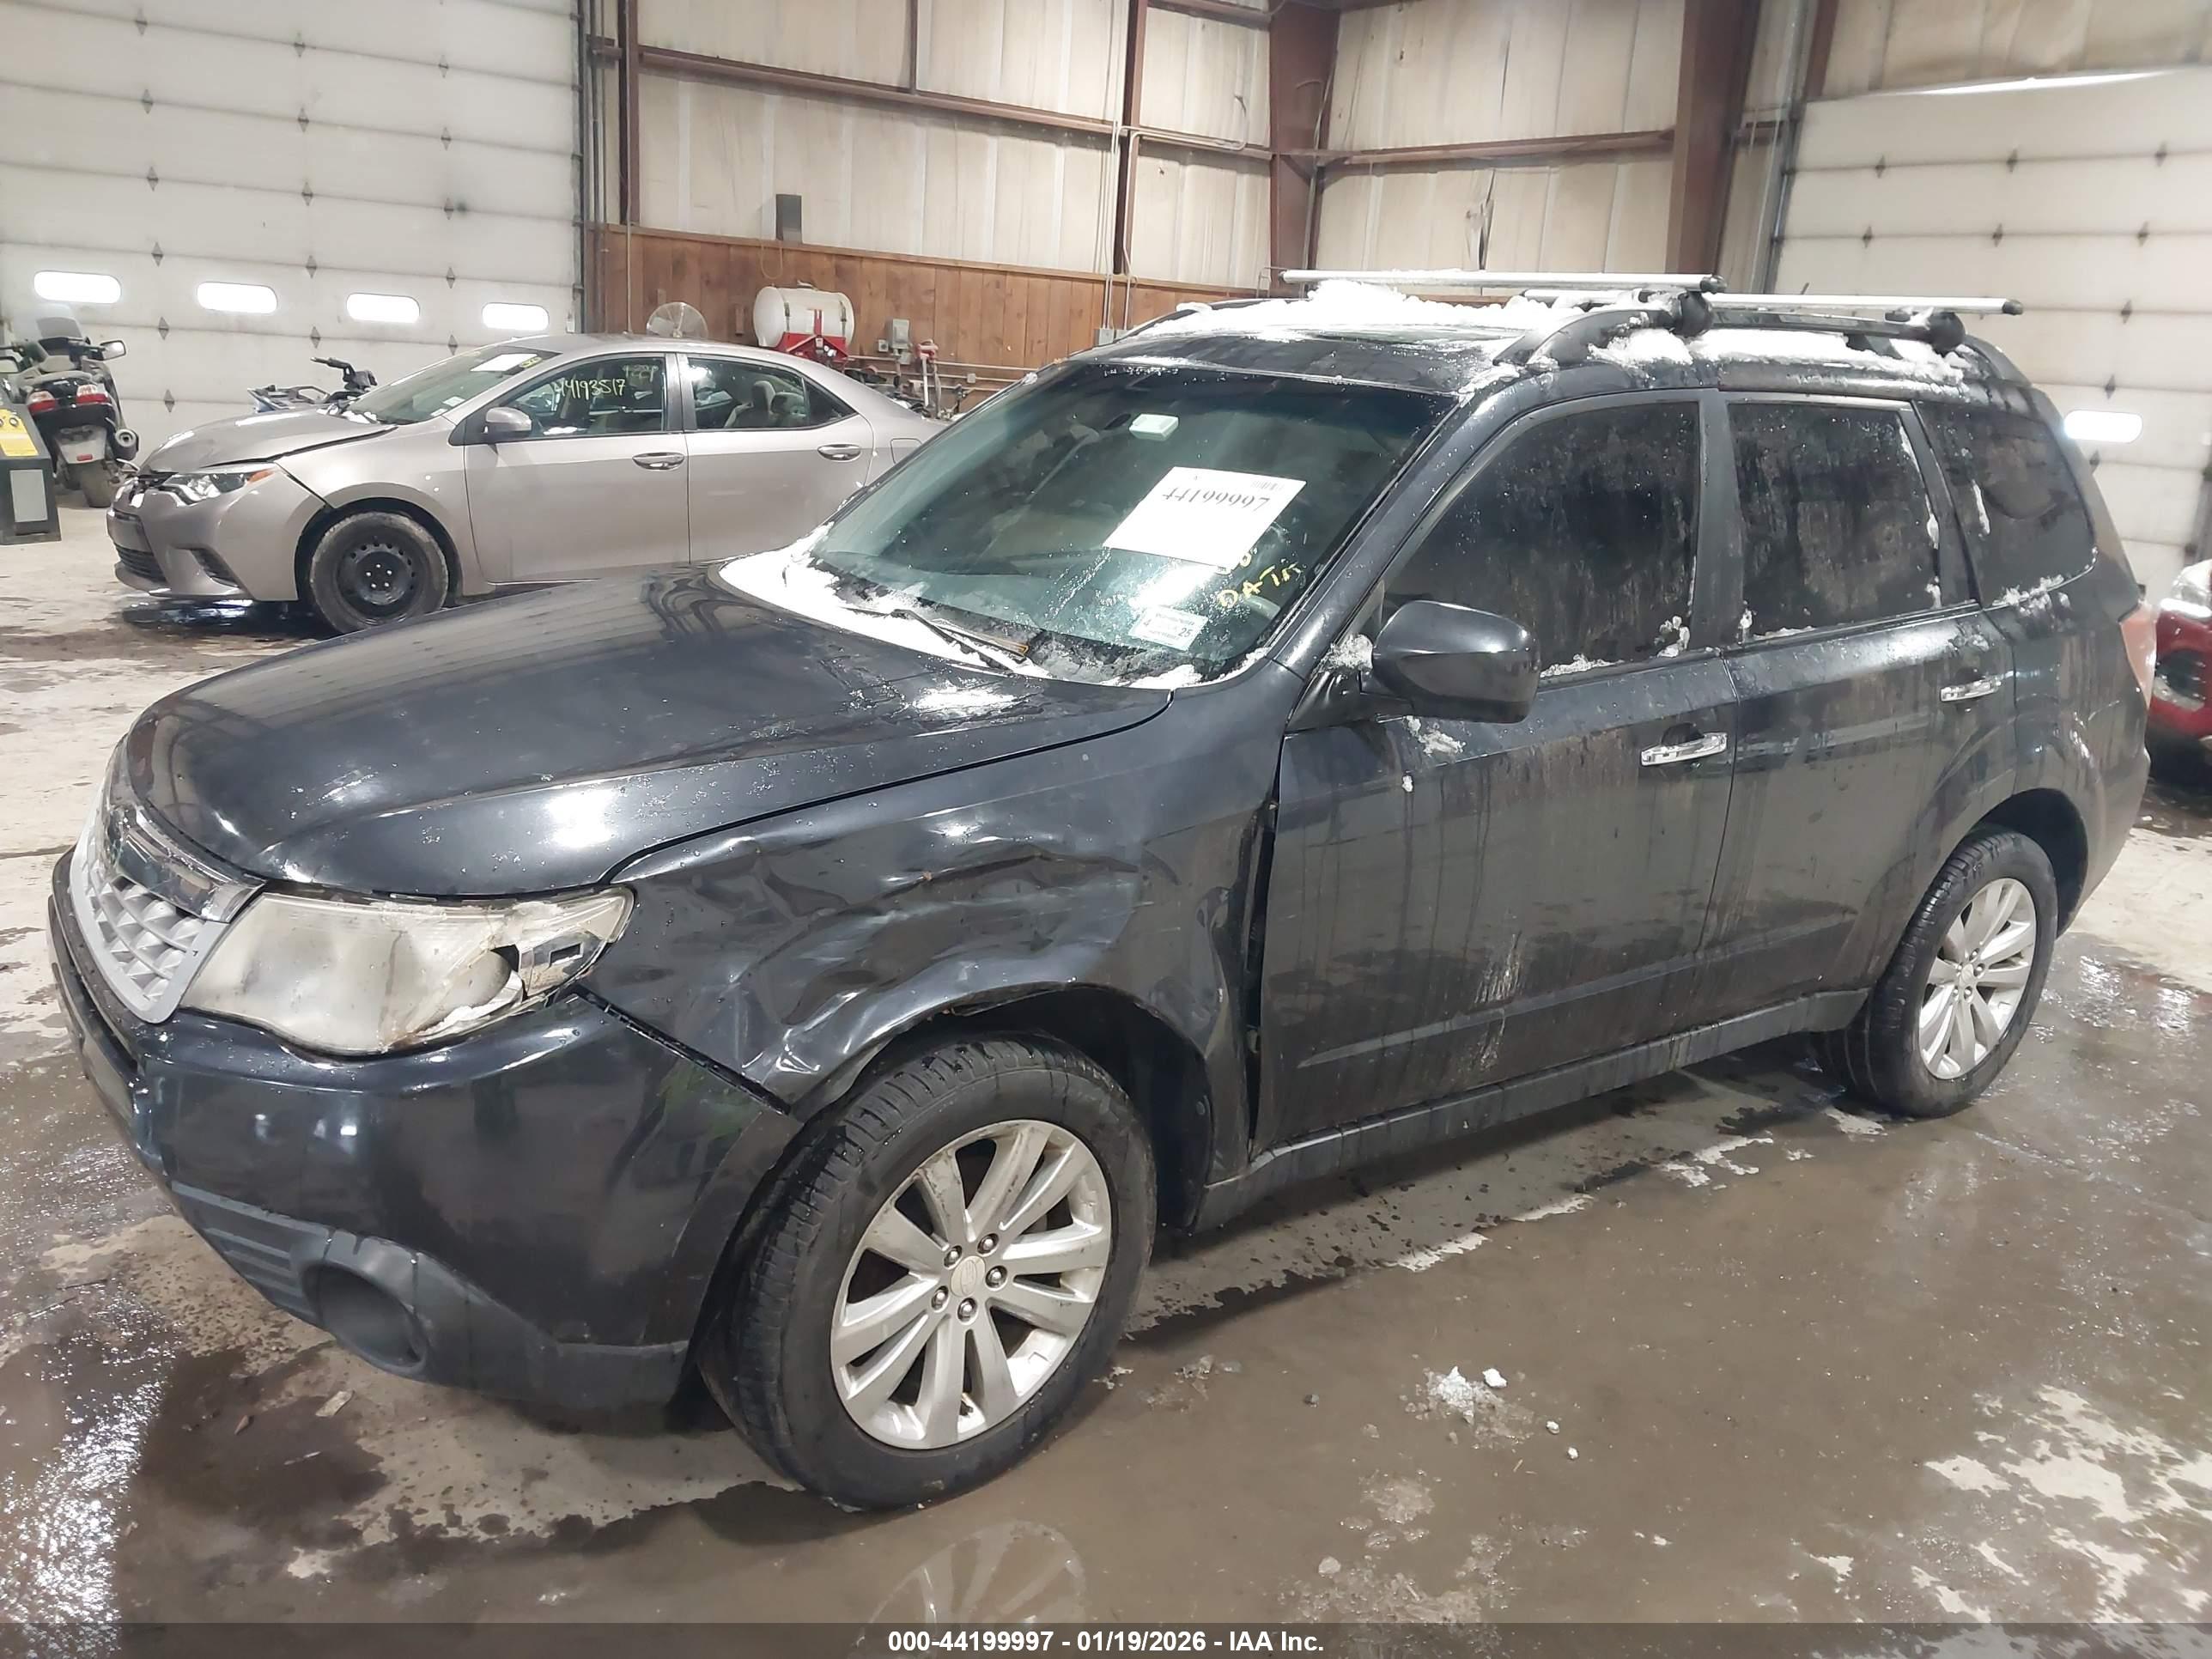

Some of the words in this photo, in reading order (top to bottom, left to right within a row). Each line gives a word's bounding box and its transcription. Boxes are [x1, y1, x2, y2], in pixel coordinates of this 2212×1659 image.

[552, 378, 626, 400] 44193517
[1162, 487, 1271, 512] 44199997
[1177, 628, 1194, 638] 25
